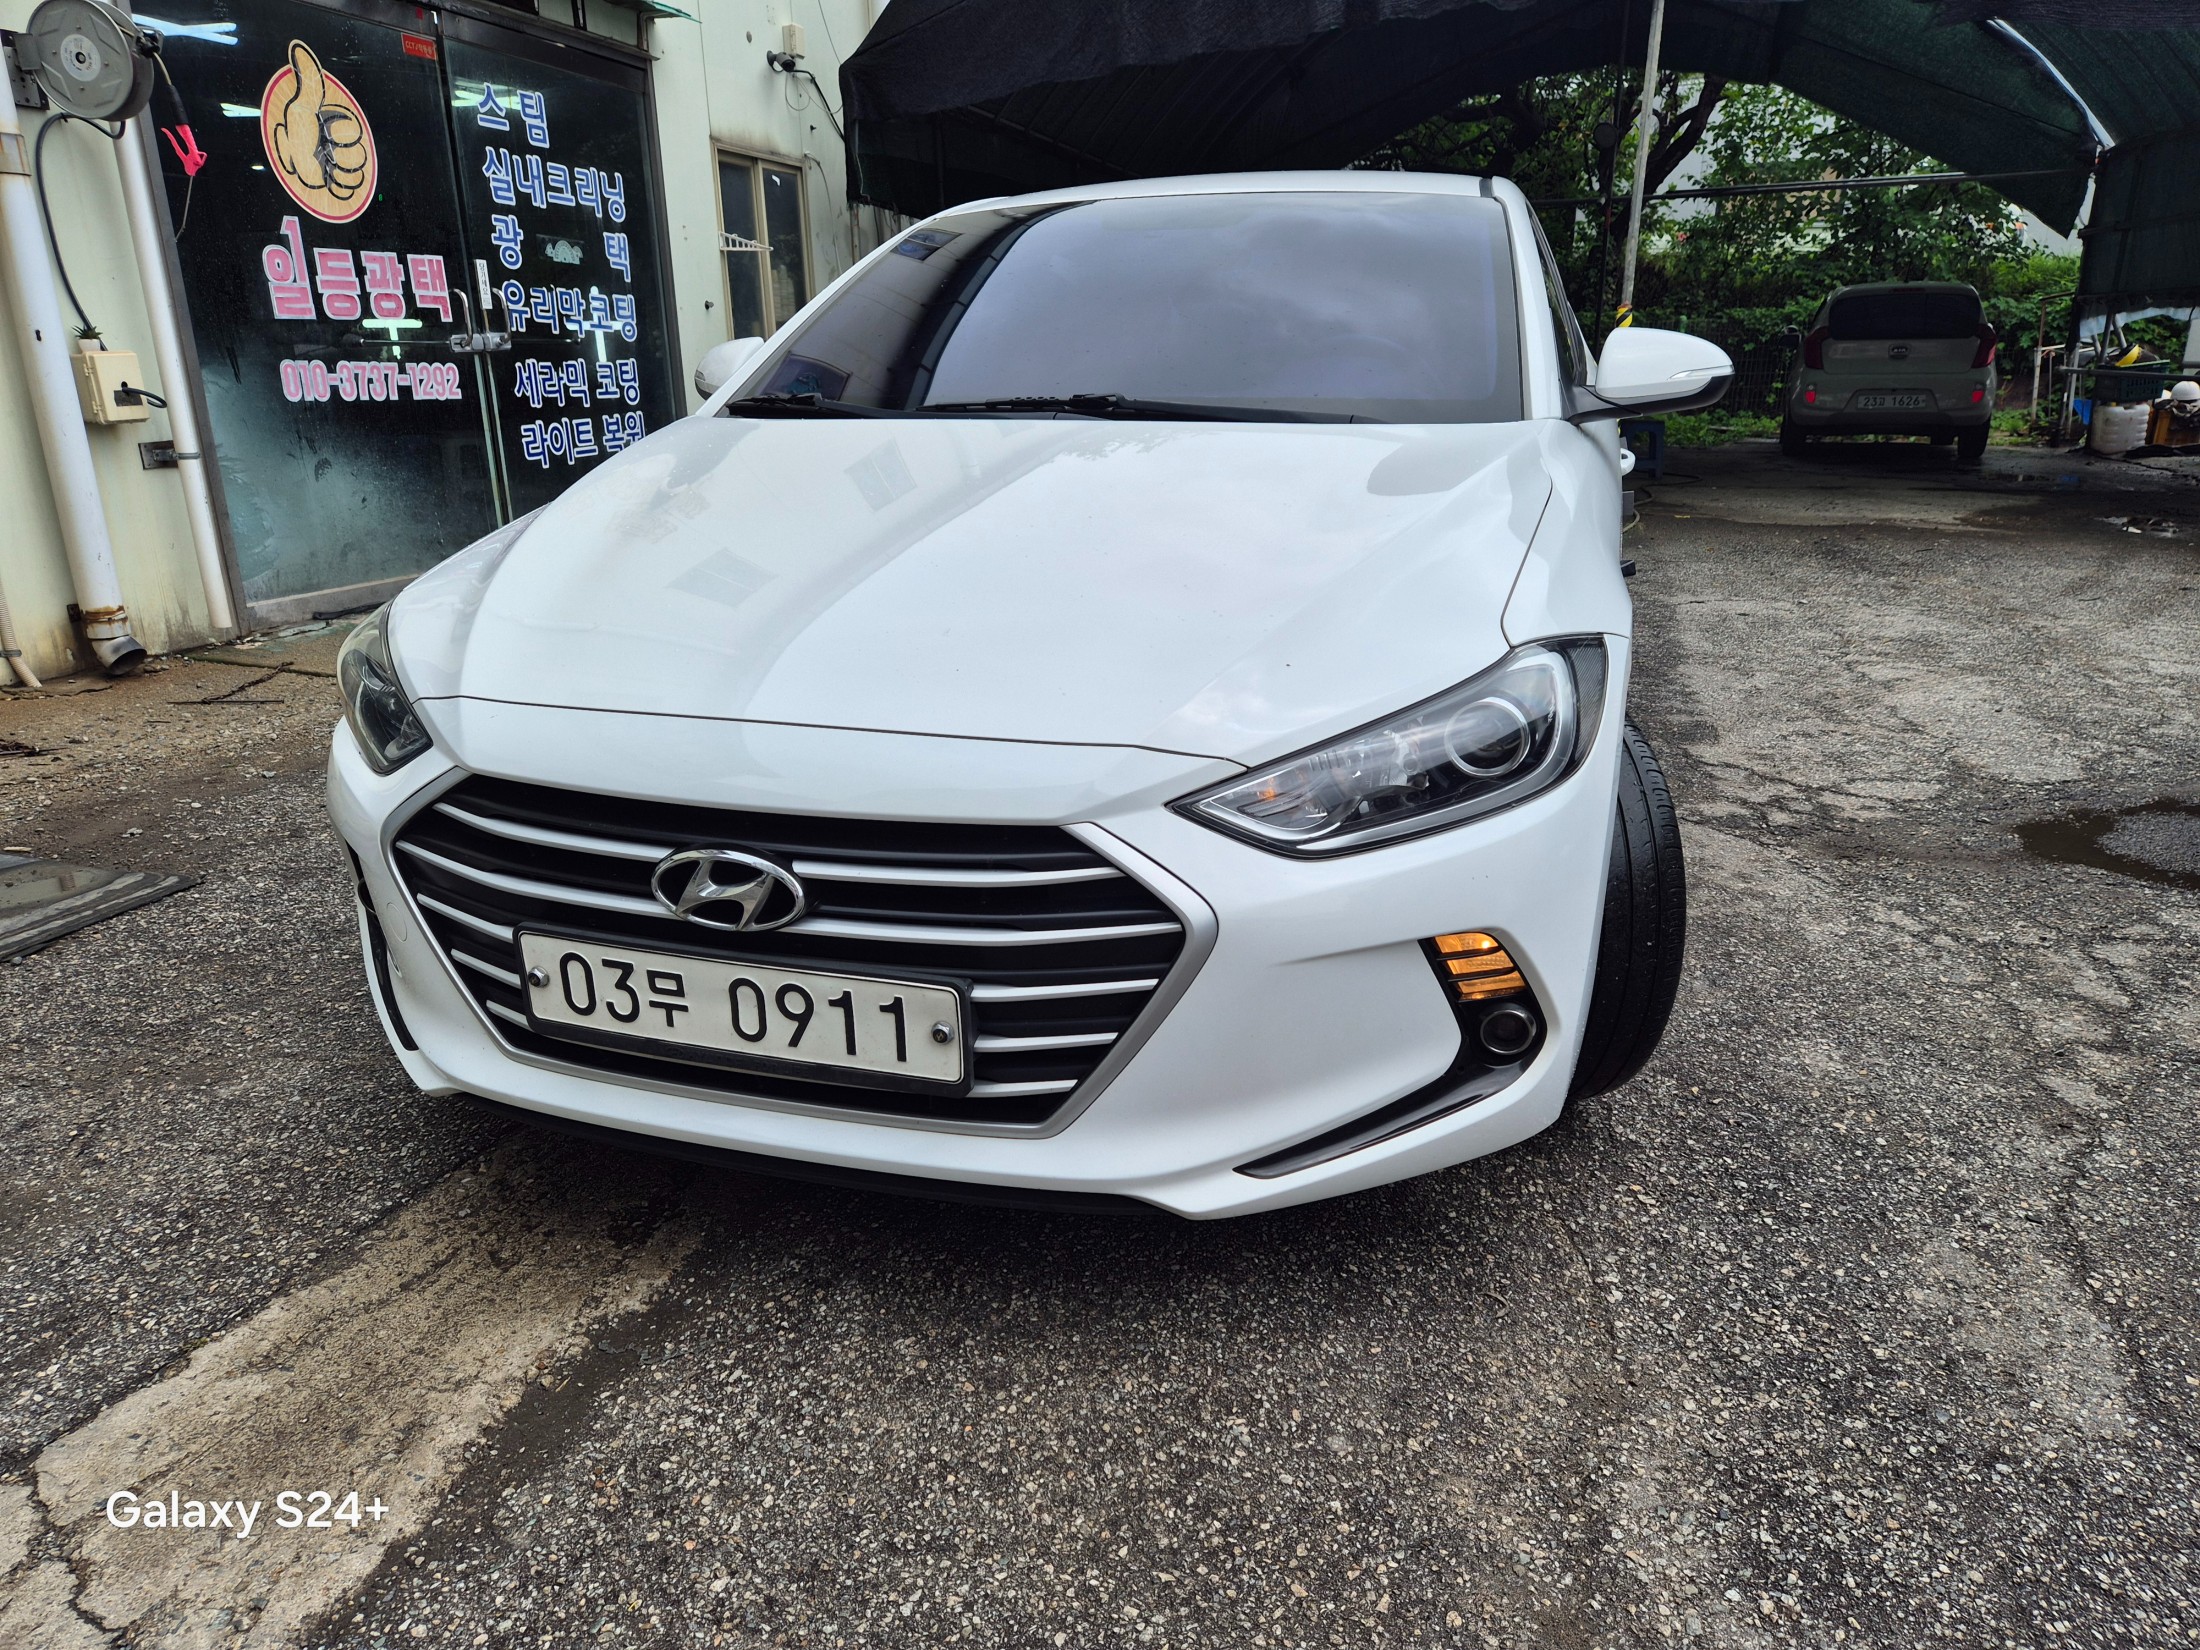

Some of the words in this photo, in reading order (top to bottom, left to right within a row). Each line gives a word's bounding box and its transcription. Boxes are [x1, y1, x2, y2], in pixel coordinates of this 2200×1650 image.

[482, 146, 626, 223] 실내크리닝
[262, 215, 453, 322] 일등광택
[280, 358, 462, 402] 010-3737-1292
[514, 358, 591, 407] 세라믹
[596, 358, 640, 405] 코팅
[1892, 395, 1920, 407] 1626
[521, 417, 599, 468] 라이트
[559, 951, 689, 1028] 03무
[728, 977, 907, 1063] 0911
